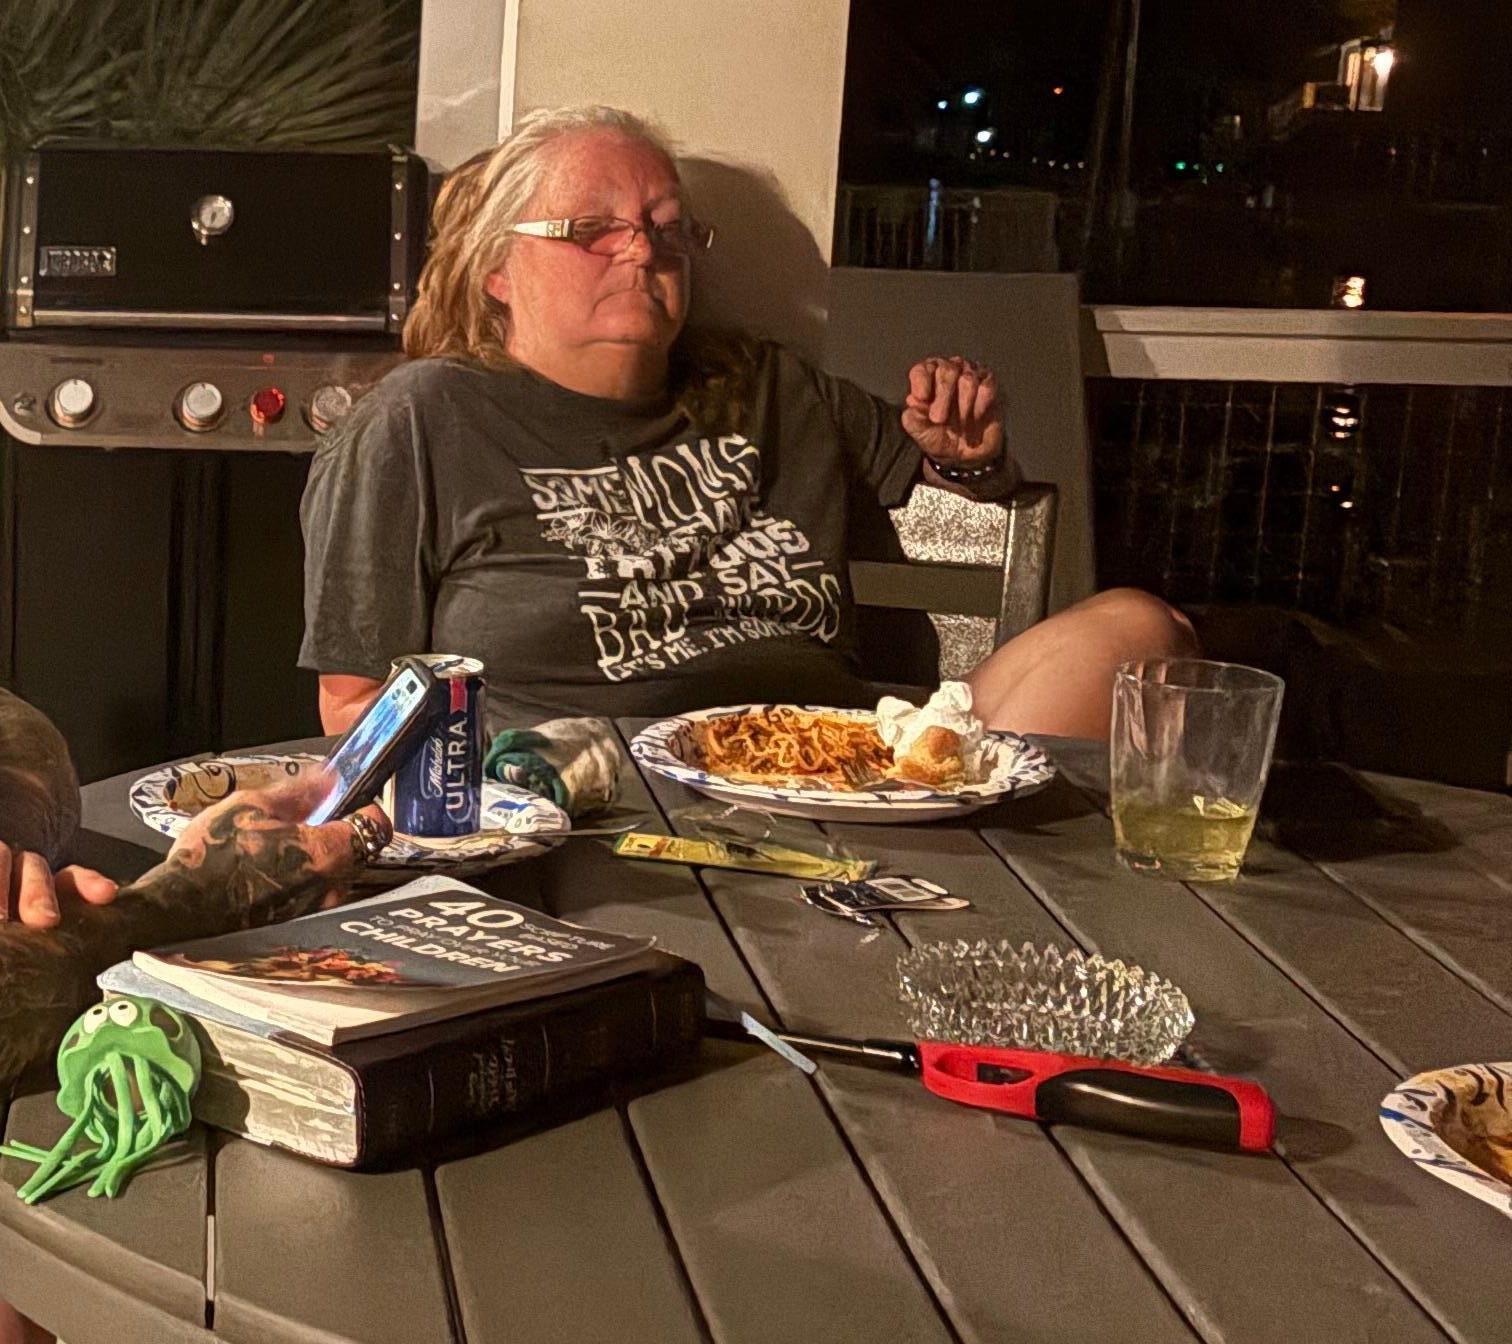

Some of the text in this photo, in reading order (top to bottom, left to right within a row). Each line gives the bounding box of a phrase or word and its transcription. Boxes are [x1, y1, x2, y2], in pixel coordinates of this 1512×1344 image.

[619, 556, 792, 609] AND SAY
[444, 718, 468, 811] ULTRA
[388, 907, 574, 963] PRAYERS
[424, 901, 525, 928] 40
[339, 920, 522, 974] CHILDREN
